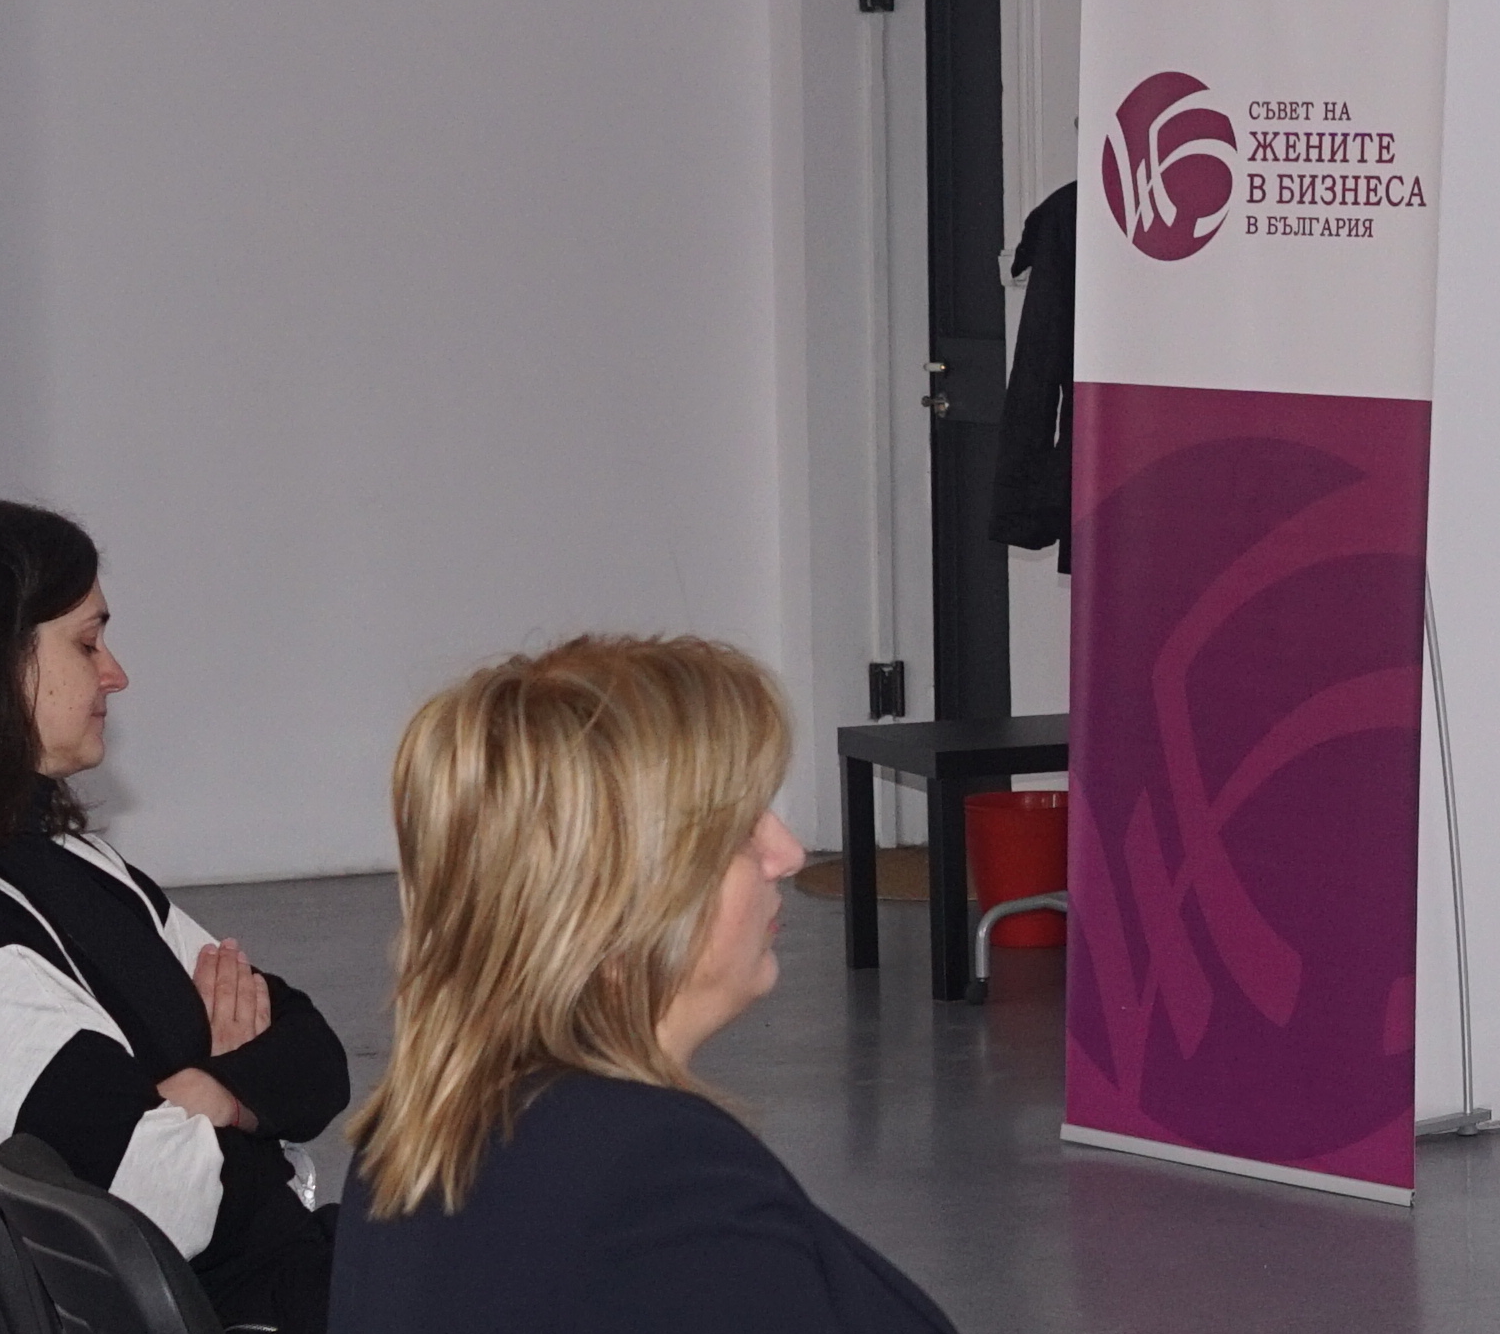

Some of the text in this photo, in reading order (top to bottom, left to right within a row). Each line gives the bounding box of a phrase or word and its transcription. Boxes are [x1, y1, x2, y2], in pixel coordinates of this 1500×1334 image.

[1249, 101, 1352, 121] СЪВЕТ НА
[1247, 131, 1395, 164] ЖЕНИТЕ
[1246, 173, 1427, 207] В БИЗНЕСА
[1245, 216, 1374, 238] В БЪЛГАРИЯ
